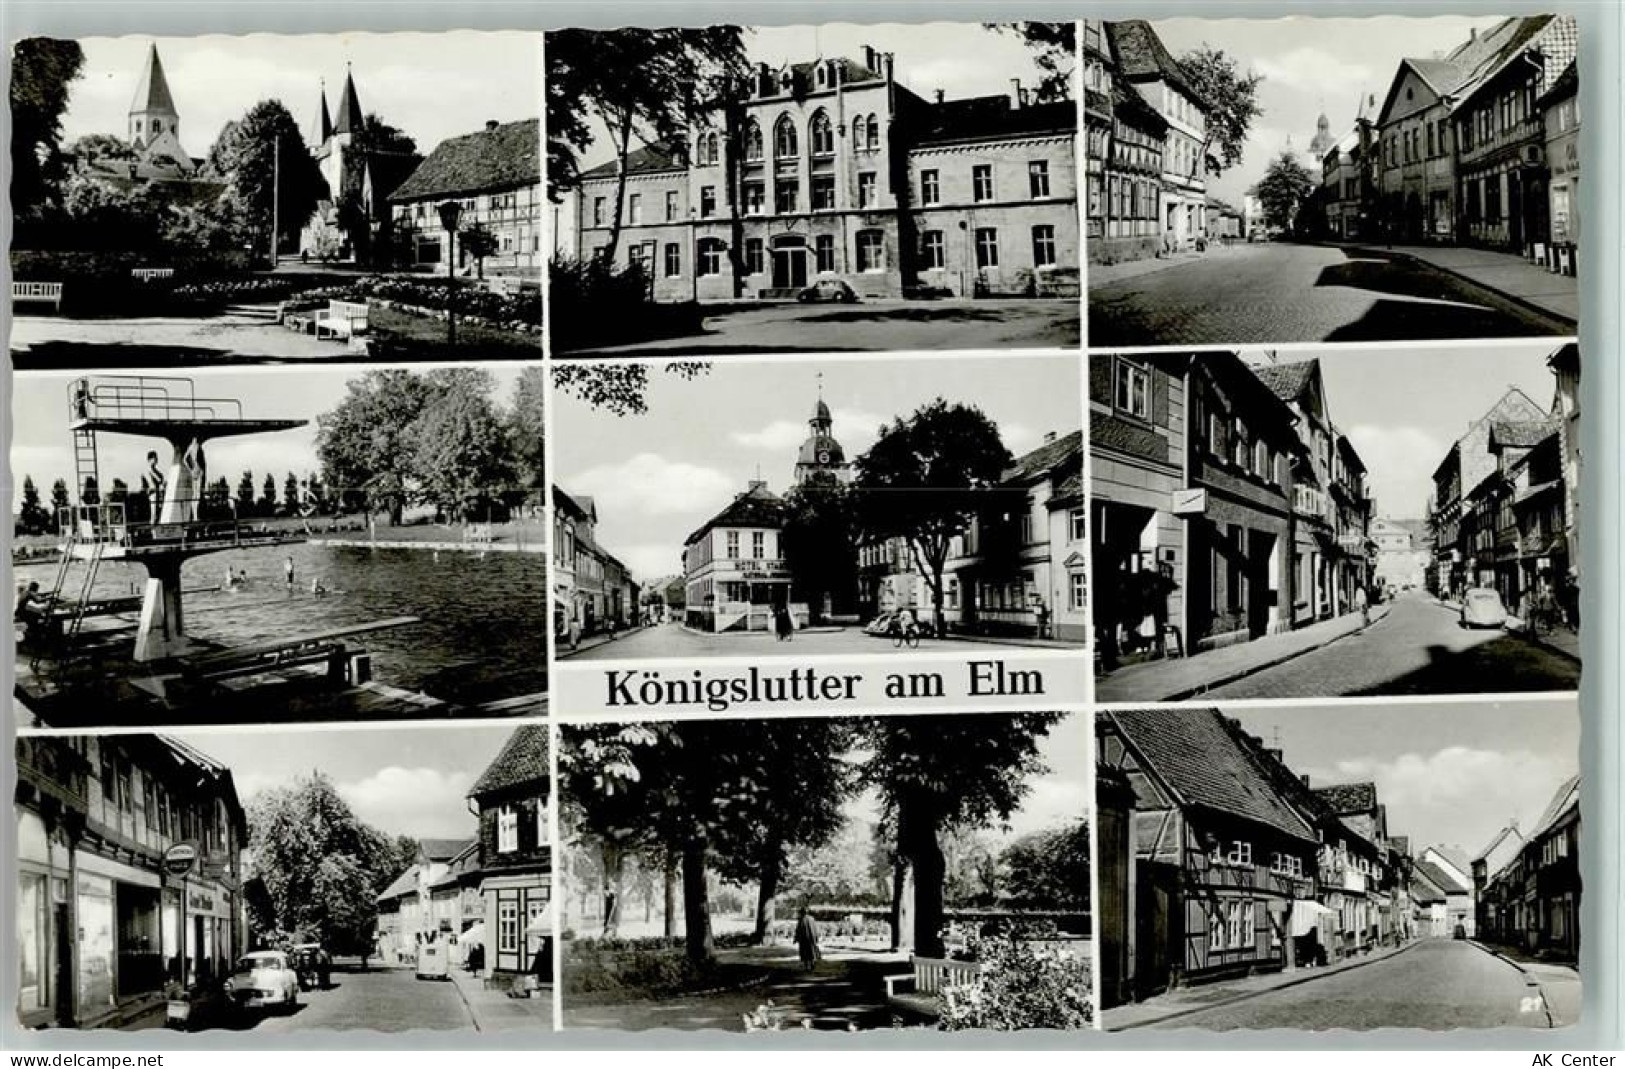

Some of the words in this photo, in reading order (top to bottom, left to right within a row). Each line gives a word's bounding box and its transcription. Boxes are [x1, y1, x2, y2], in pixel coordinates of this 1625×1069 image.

[605, 667, 862, 710] Königslutter
[886, 671, 946, 697] am
[967, 661, 1046, 696] Elm
